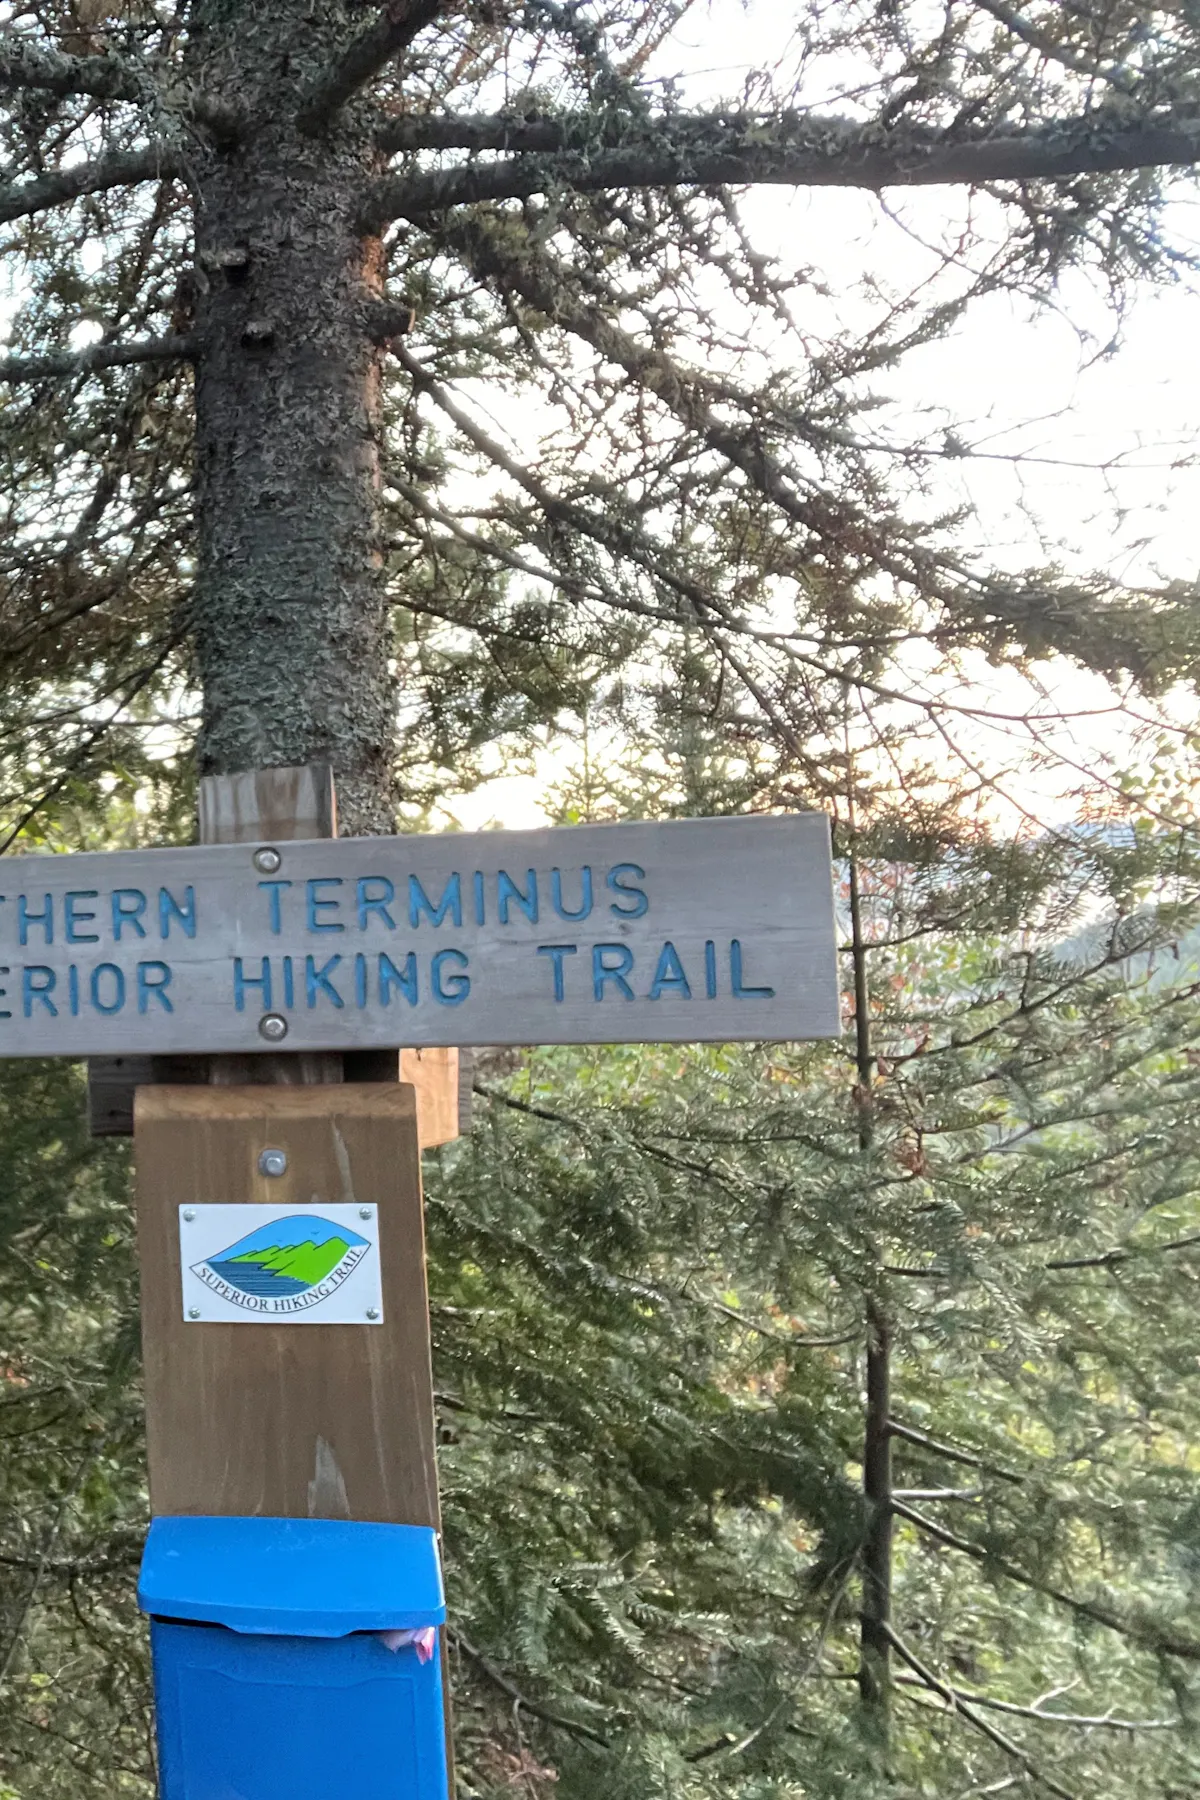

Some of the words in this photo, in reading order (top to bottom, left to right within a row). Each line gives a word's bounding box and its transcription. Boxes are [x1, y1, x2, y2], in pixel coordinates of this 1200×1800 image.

[258, 862, 650, 935] TERMINUS
[232, 948, 472, 1012] HIKING
[536, 938, 776, 1003] TRAIL
[200, 1267, 269, 1311] SUPERIOR
[274, 1283, 330, 1311] HIKING
[326, 1248, 362, 1287] TRAIL
